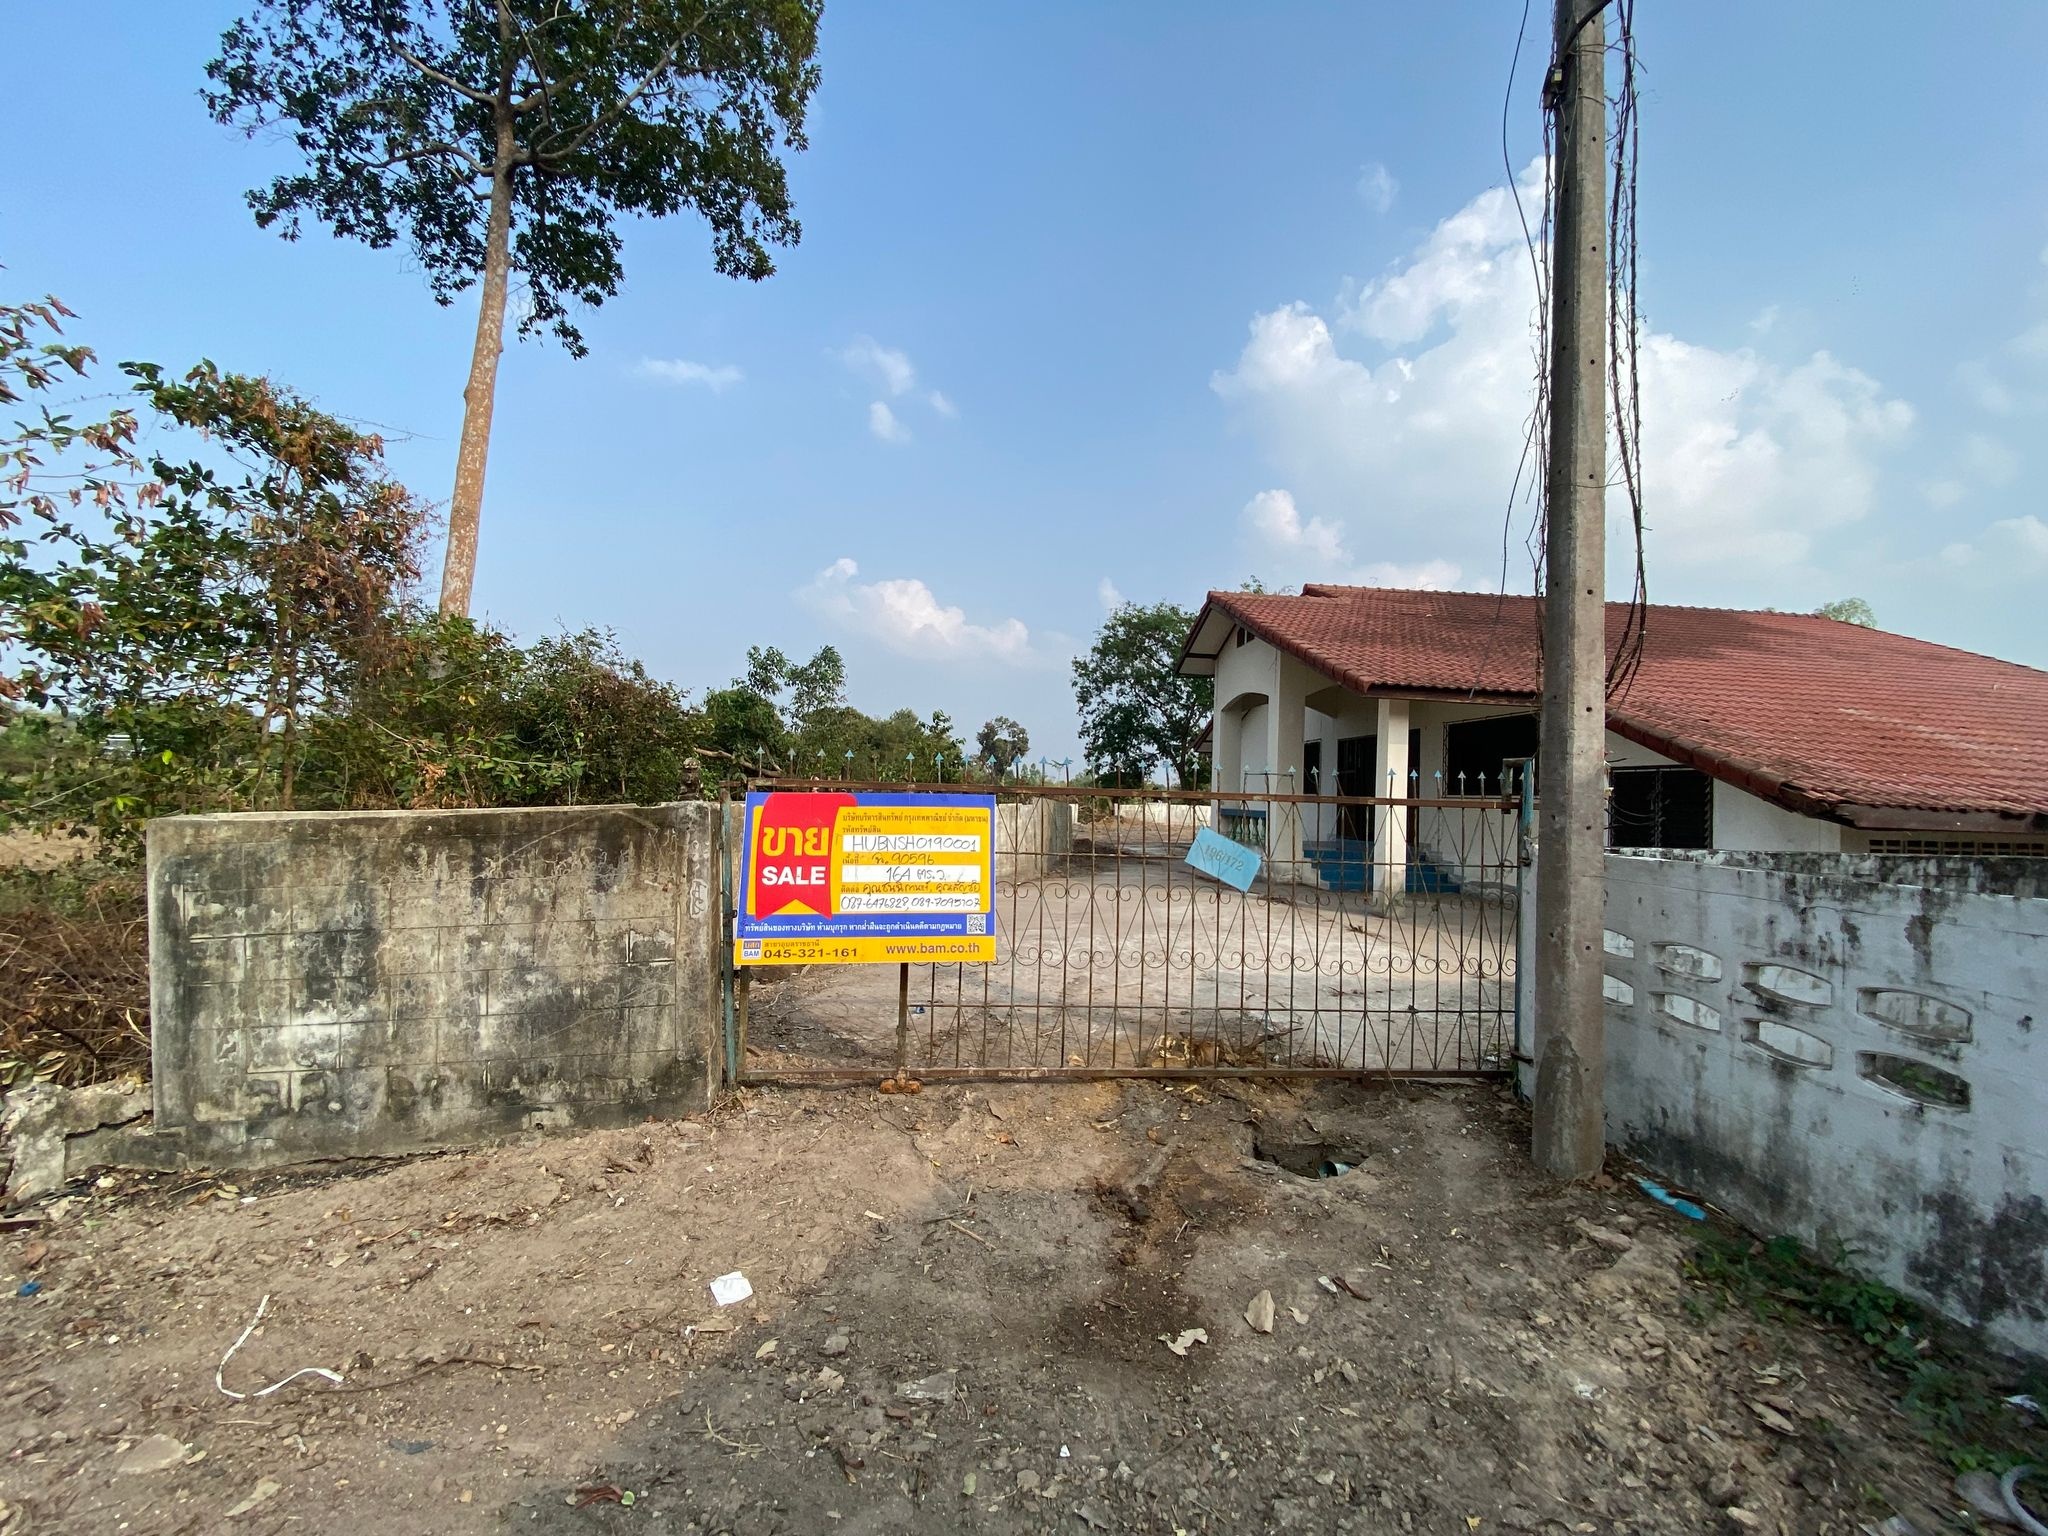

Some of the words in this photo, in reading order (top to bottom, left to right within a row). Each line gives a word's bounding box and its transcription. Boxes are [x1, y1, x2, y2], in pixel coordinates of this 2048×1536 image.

[762, 827, 830, 857] ขาย
[761, 866, 826, 885] SALE
[763, 948, 858, 958] 045-321-161
[885, 943, 980, 954] www.bam.co.th
